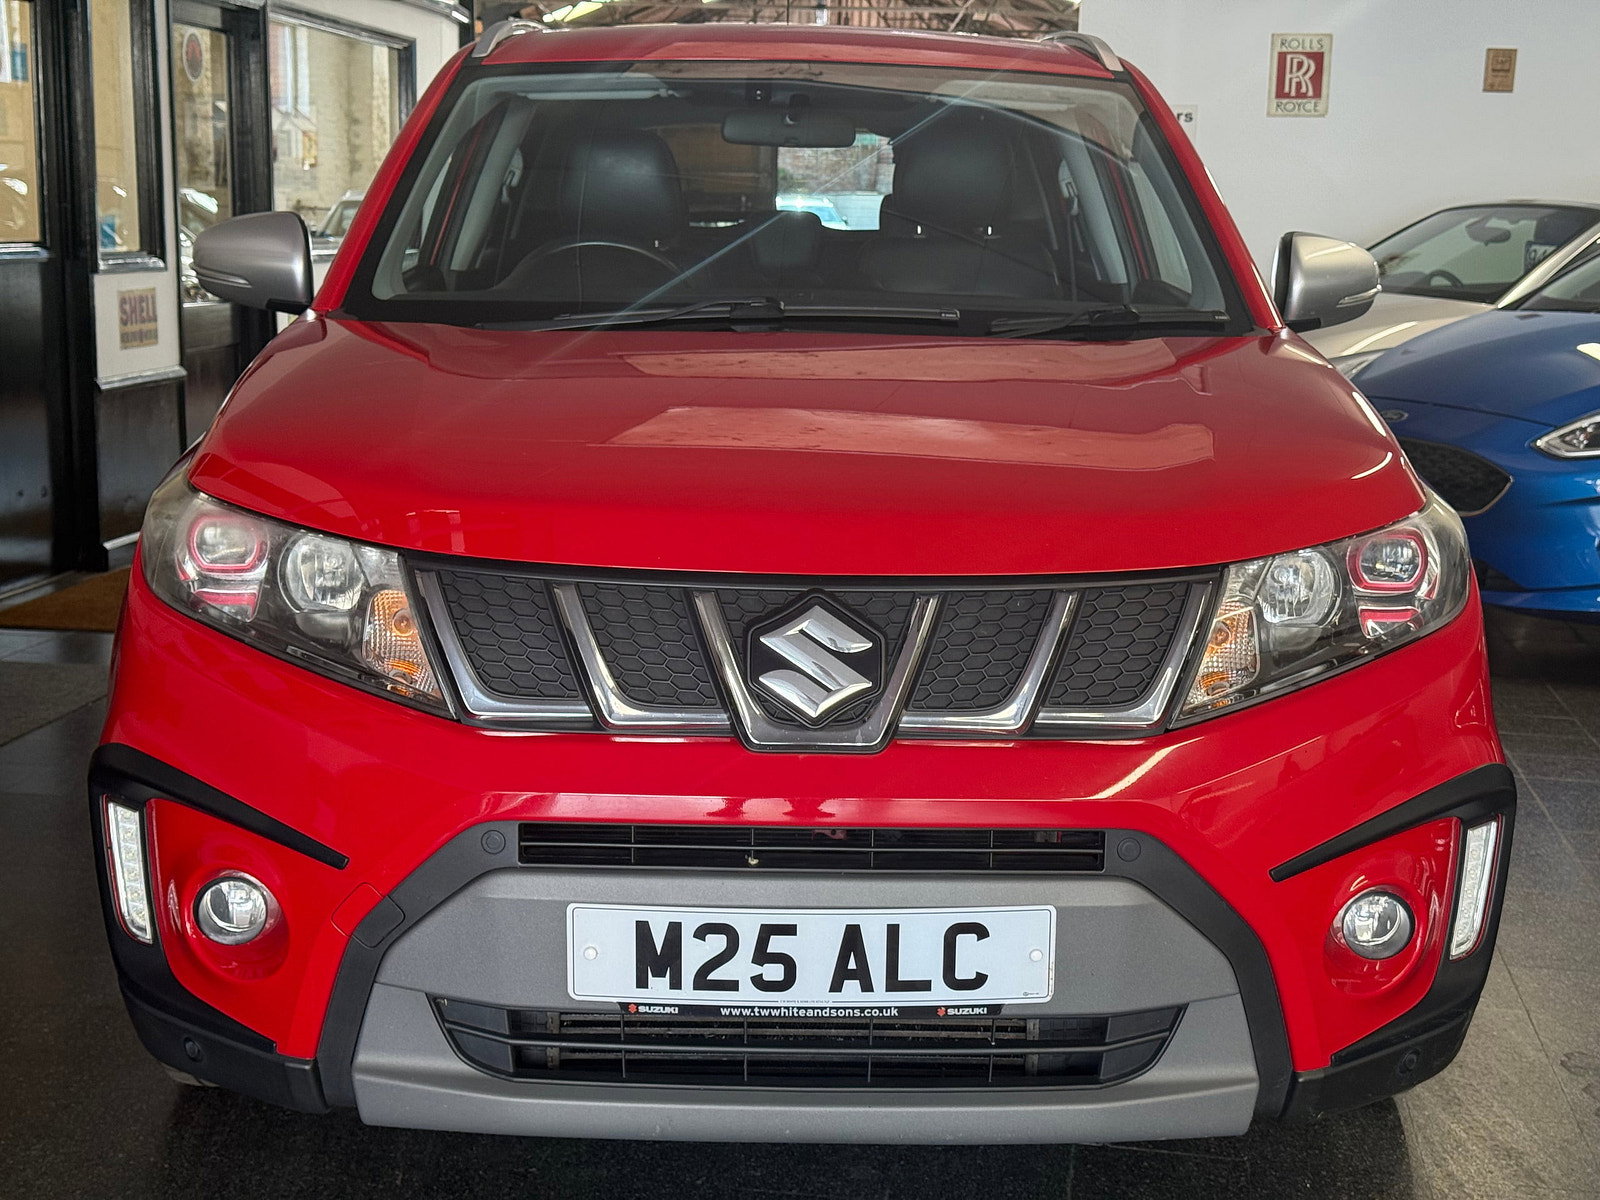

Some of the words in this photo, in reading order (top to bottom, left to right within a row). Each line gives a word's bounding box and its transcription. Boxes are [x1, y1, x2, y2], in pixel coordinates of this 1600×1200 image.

[1280, 38, 1324, 50] ROLLS
[1275, 101, 1320, 113] ROYCE
[119, 294, 157, 327] SHELL
[635, 920, 798, 993] M25
[828, 921, 990, 994] ALC
[638, 1005, 679, 1014] SUZUKI
[720, 1006, 899, 1017] www.twwhiteandsons.co.uk
[947, 1007, 988, 1016] SUZUKI
